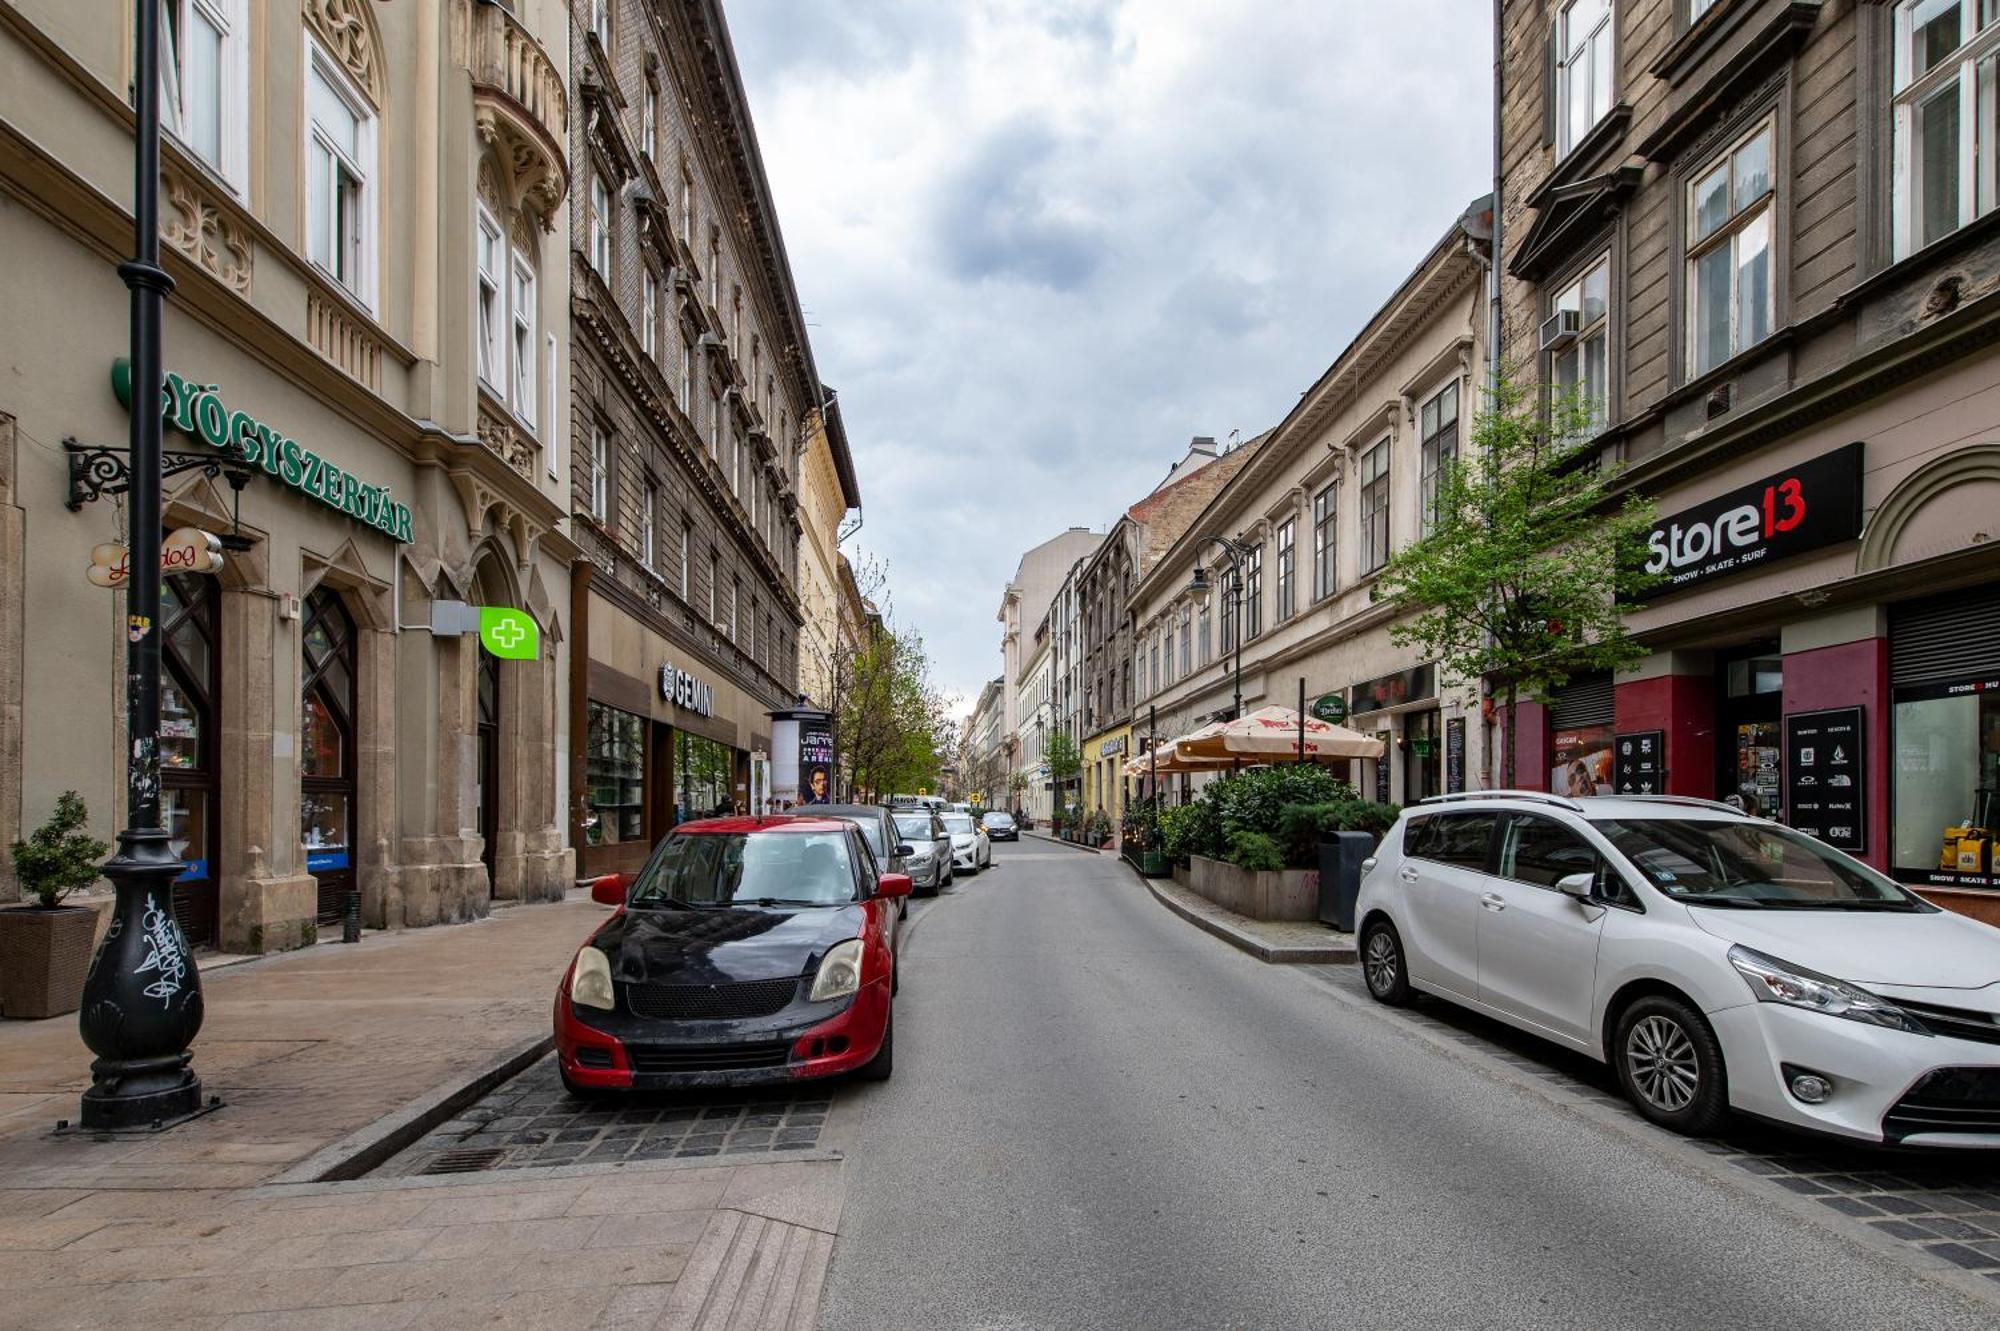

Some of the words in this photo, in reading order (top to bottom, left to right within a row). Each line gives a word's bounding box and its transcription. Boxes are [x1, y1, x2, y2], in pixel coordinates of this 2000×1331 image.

[161, 368, 415, 544] YÓGYSZERTÁR
[1645, 477, 1807, 575] Store13
[1672, 569, 1699, 584] SNOW
[1705, 558, 1735, 575] SKATE
[1741, 548, 1767, 563] SURF
[676, 667, 714, 719] GEMINI
[1929, 874, 1954, 882] SNOW
[1960, 876, 1987, 885] SKATE
